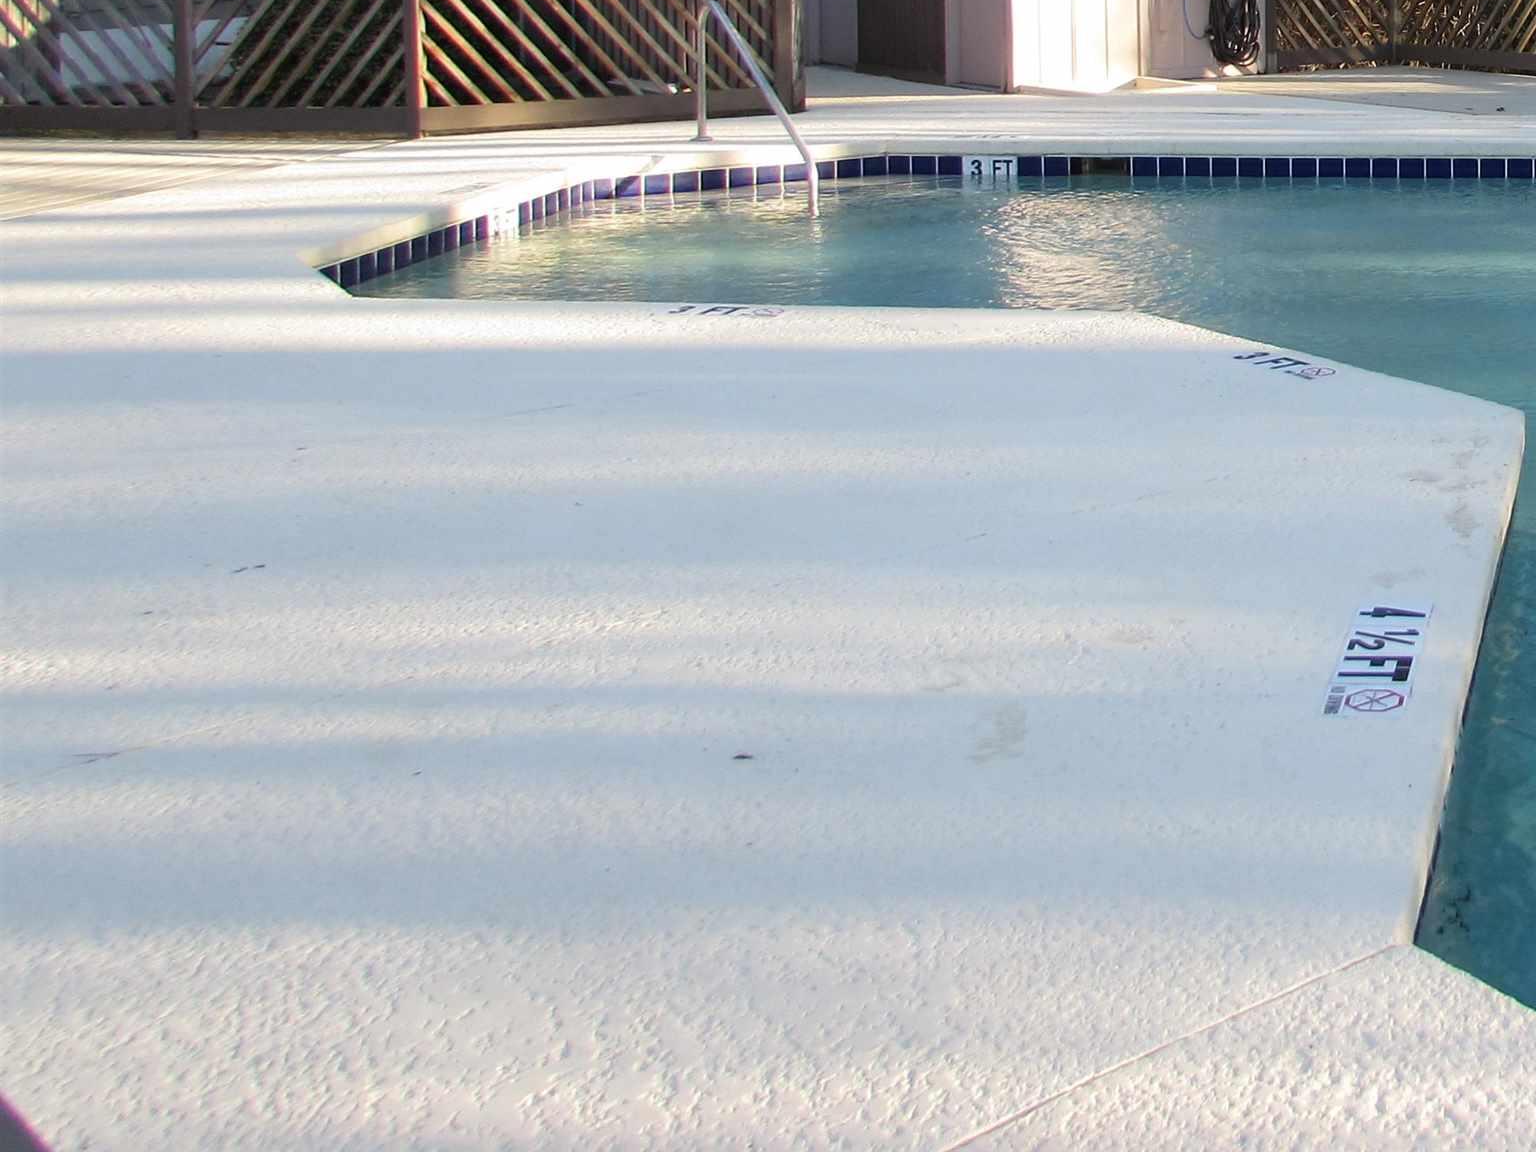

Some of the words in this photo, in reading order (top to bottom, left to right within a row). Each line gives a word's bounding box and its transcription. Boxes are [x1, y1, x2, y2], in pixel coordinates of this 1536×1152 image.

[970, 159, 982, 176] 3
[992, 159, 1013, 177] FT
[1253, 356, 1311, 369] FT
[1359, 606, 1426, 618] 4
[1337, 655, 1414, 682] FT
